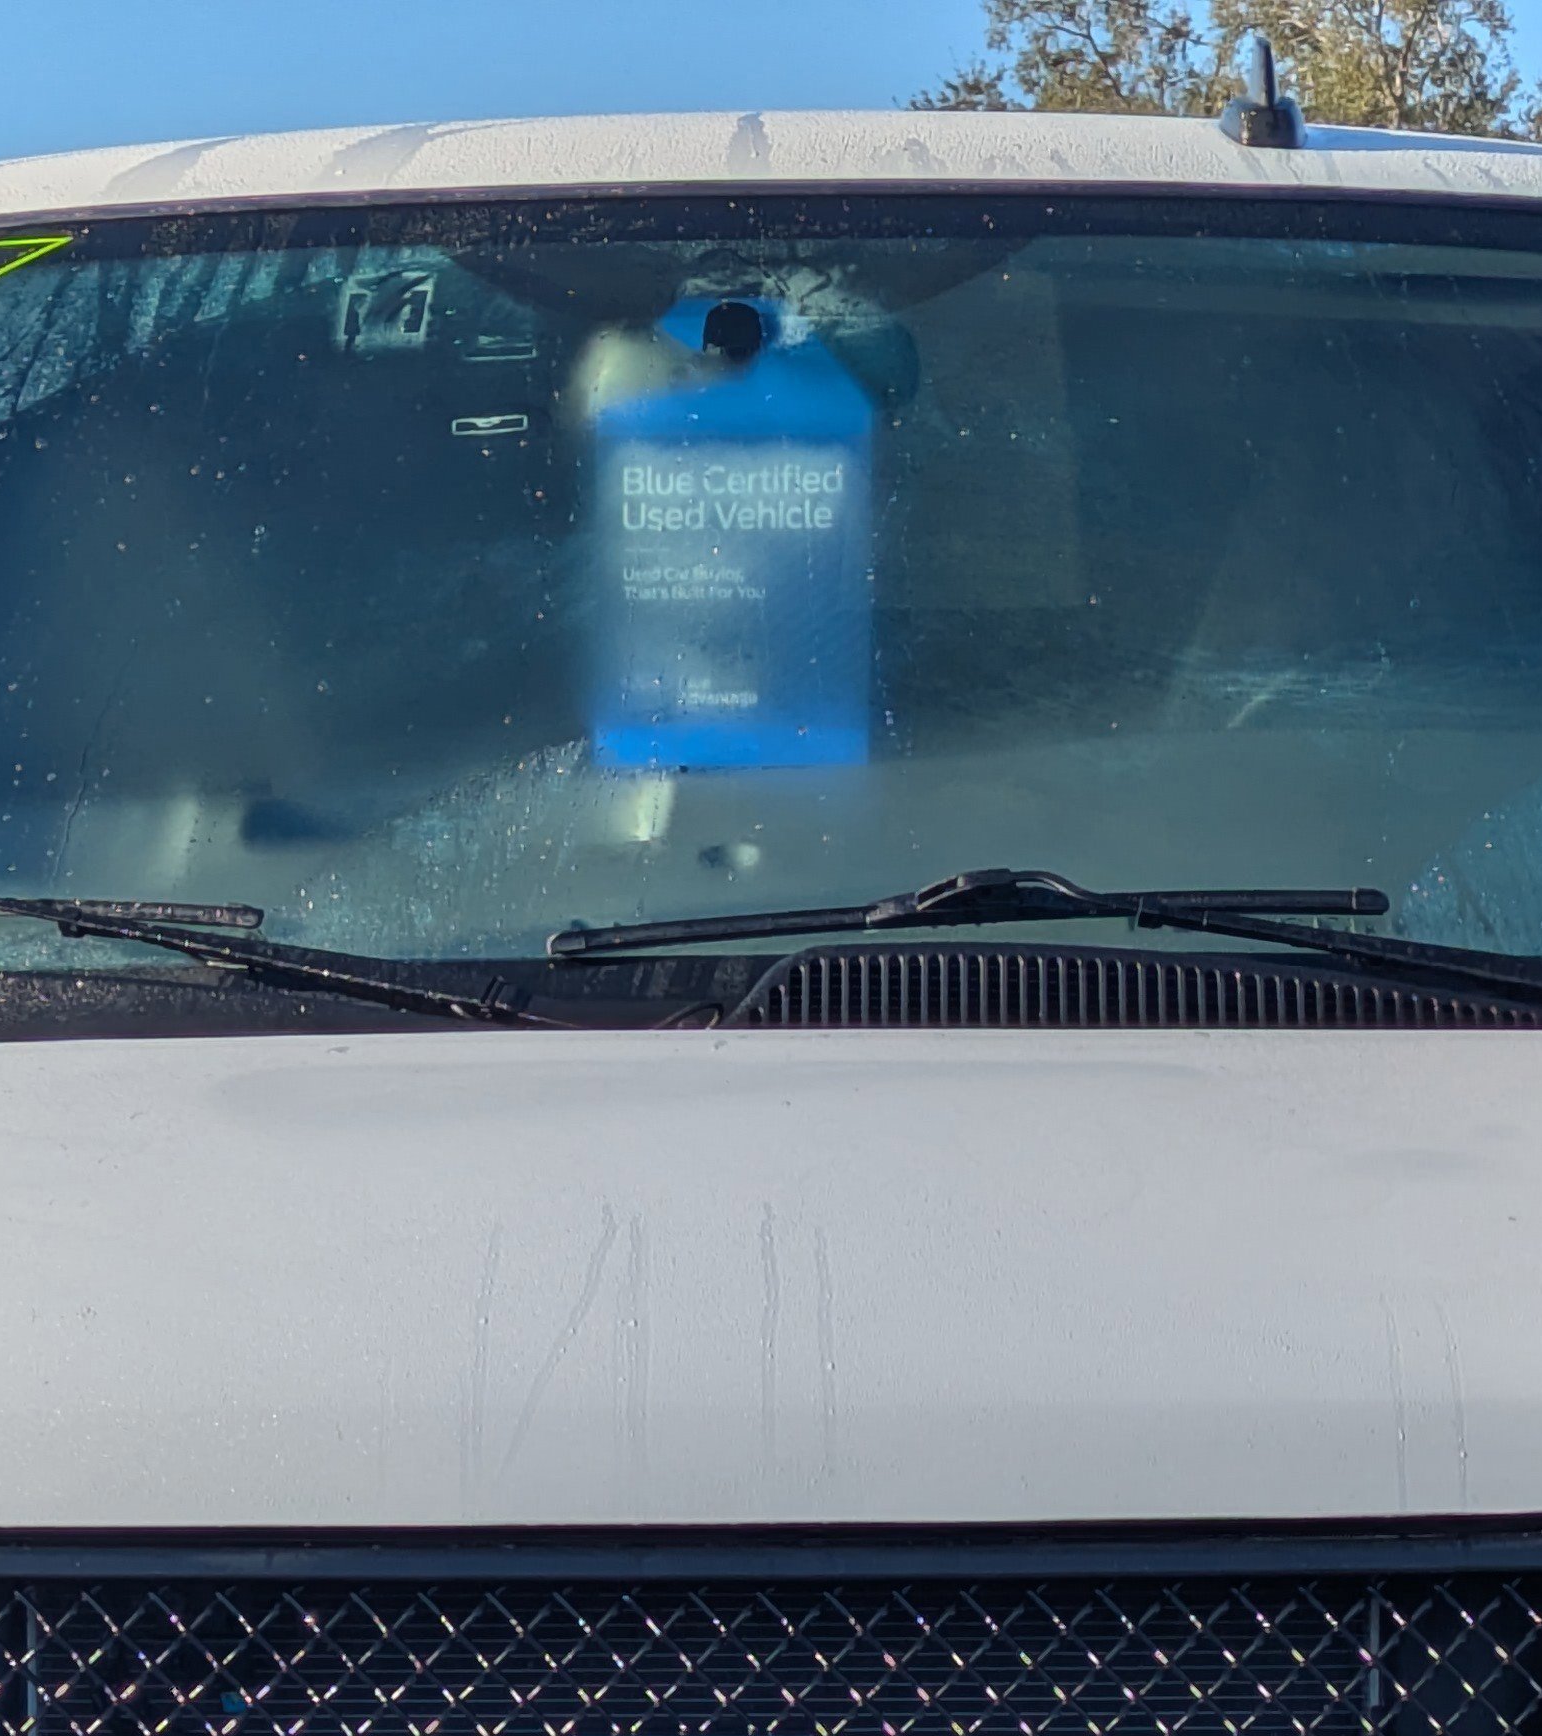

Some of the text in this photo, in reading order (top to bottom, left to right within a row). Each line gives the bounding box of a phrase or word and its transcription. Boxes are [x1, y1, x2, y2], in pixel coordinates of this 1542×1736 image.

[623, 463, 843, 495] Blue Certified
[622, 501, 833, 531] Used Vehicle
